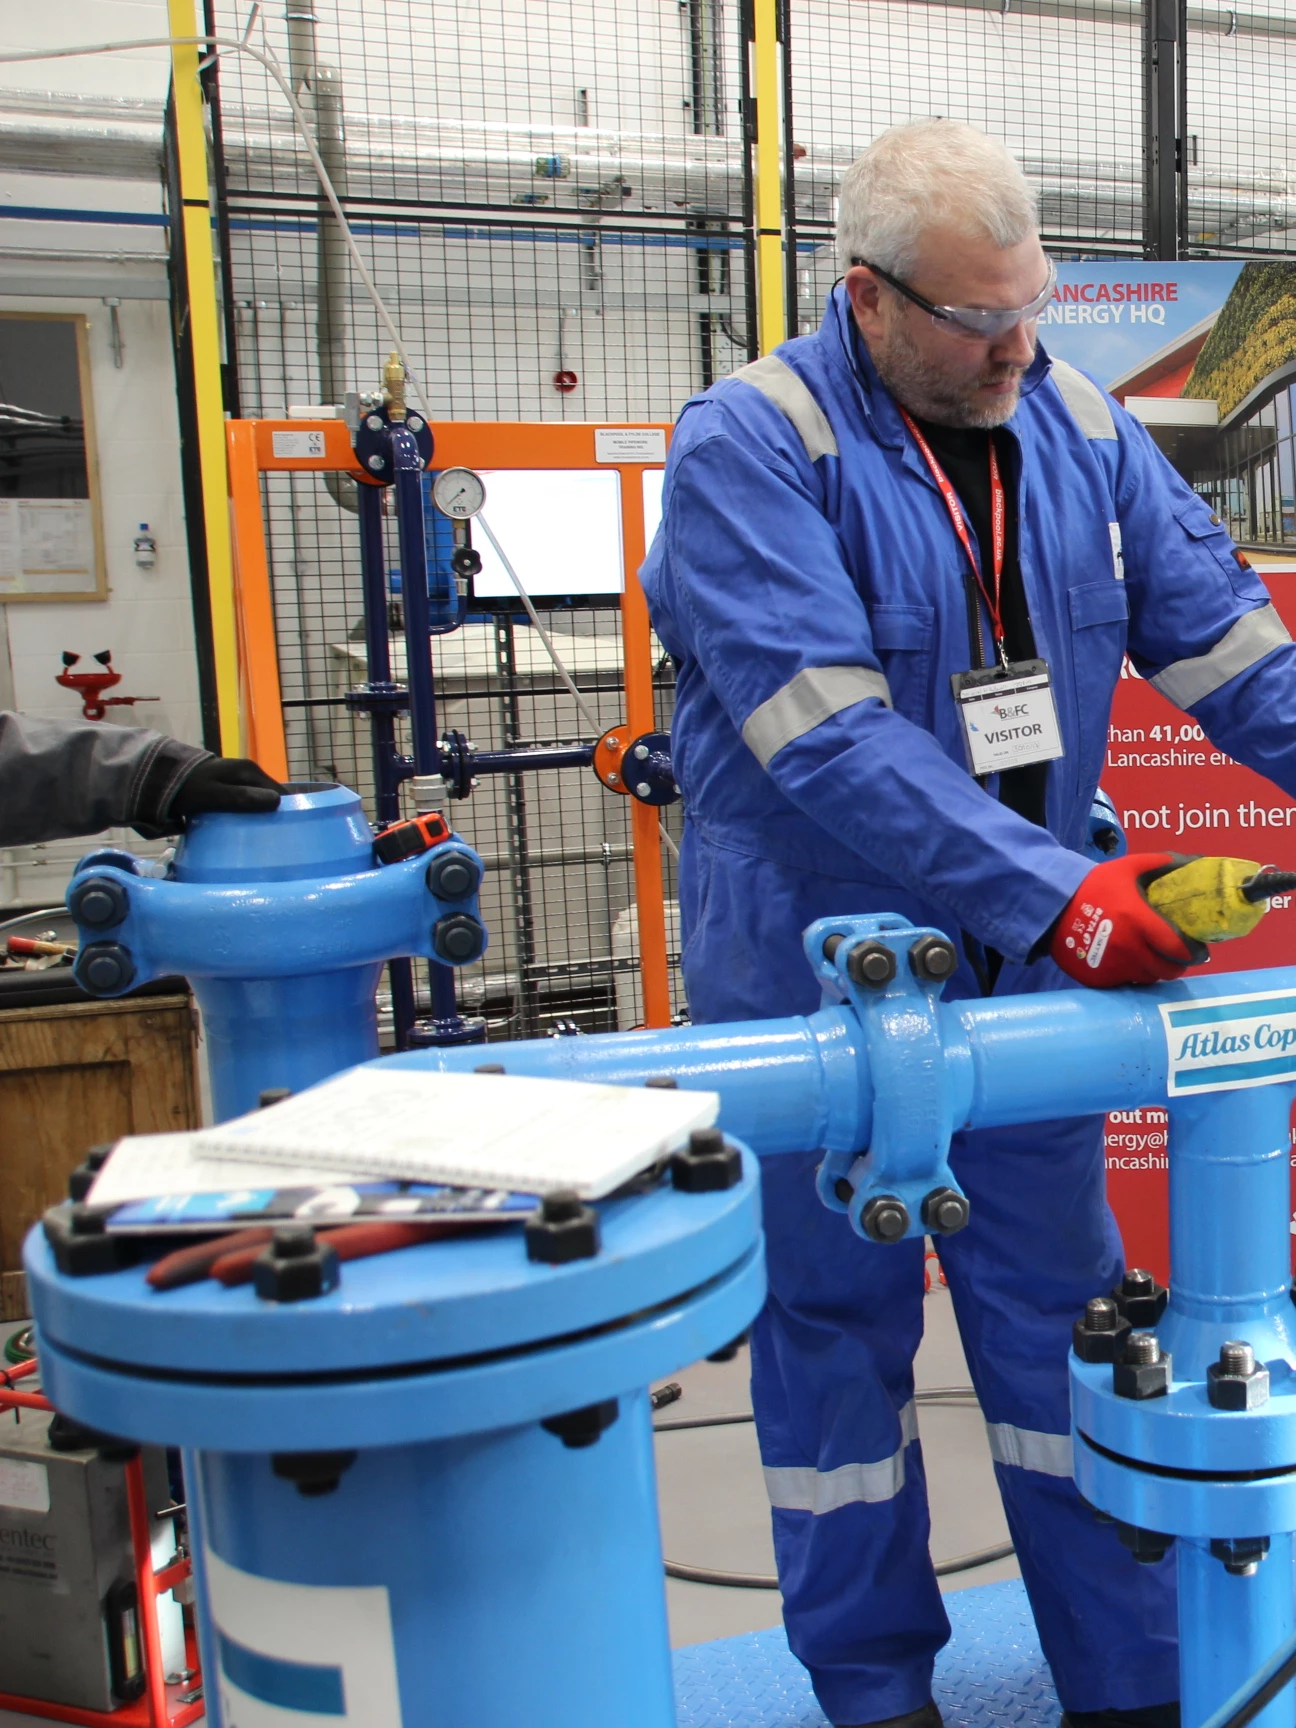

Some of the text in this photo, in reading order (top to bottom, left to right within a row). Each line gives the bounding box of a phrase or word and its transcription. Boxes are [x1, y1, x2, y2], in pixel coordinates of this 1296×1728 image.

[1051, 283, 1178, 303] ANCASHIRE
[1131, 304, 1166, 326] HQ
[946, 492, 963, 531] VISITOR
[1000, 704, 1029, 719] B&FC
[984, 723, 1043, 744] VISITOR
[1107, 748, 1206, 767] Lancashire
[1123, 805, 1171, 829] not
[1175, 802, 1230, 836] join
[1174, 1031, 1251, 1061] Atlas
[1109, 1109, 1168, 1124] out m
[1104, 1152, 1169, 1169] ncashi
